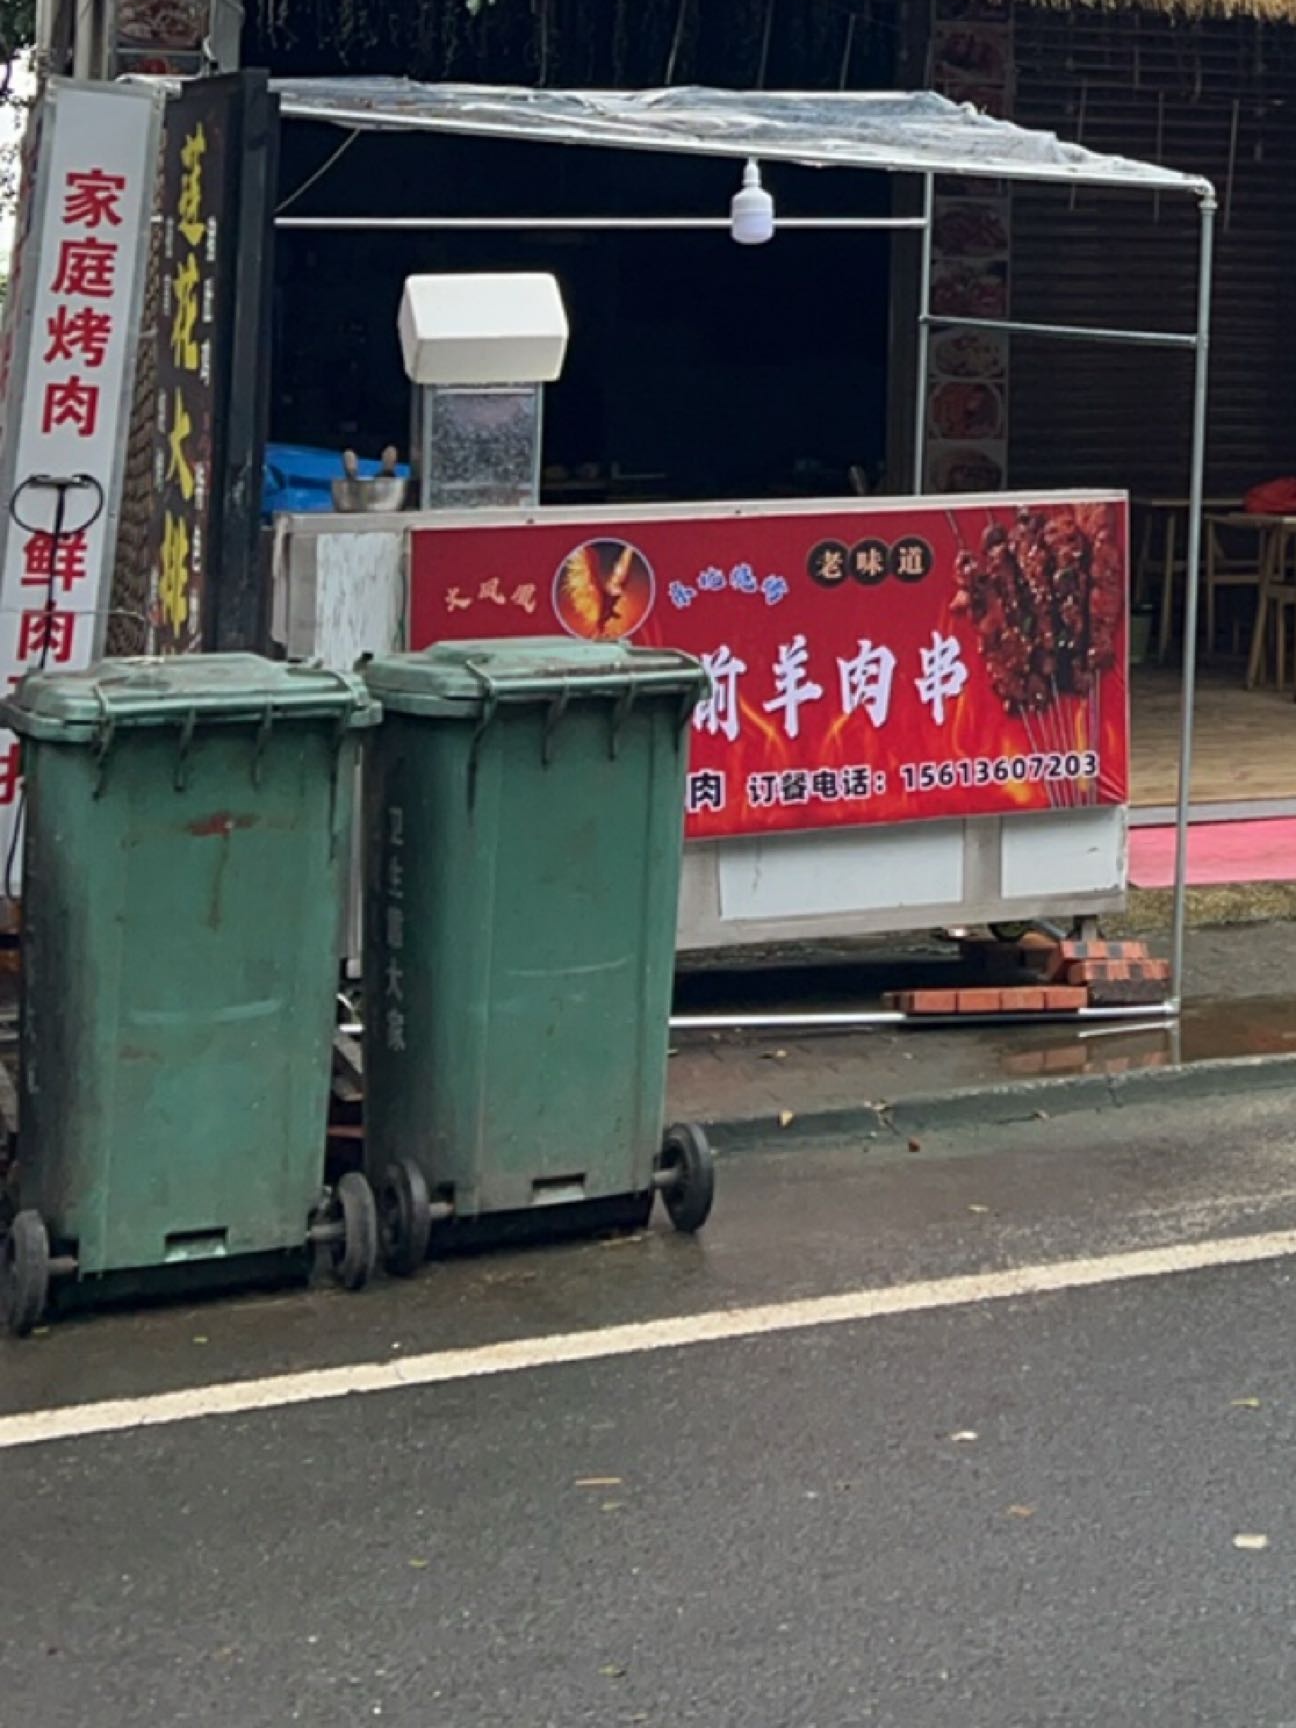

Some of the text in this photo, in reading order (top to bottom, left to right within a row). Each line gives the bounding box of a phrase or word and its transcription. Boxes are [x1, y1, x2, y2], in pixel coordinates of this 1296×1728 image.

[41, 169, 127, 437] 家庭烤肉
[160, 121, 208, 656] 莲花大排
[815, 545, 927, 579] 老味道
[693, 630, 969, 744] 前羊肉串
[686, 768, 726, 813] 肉
